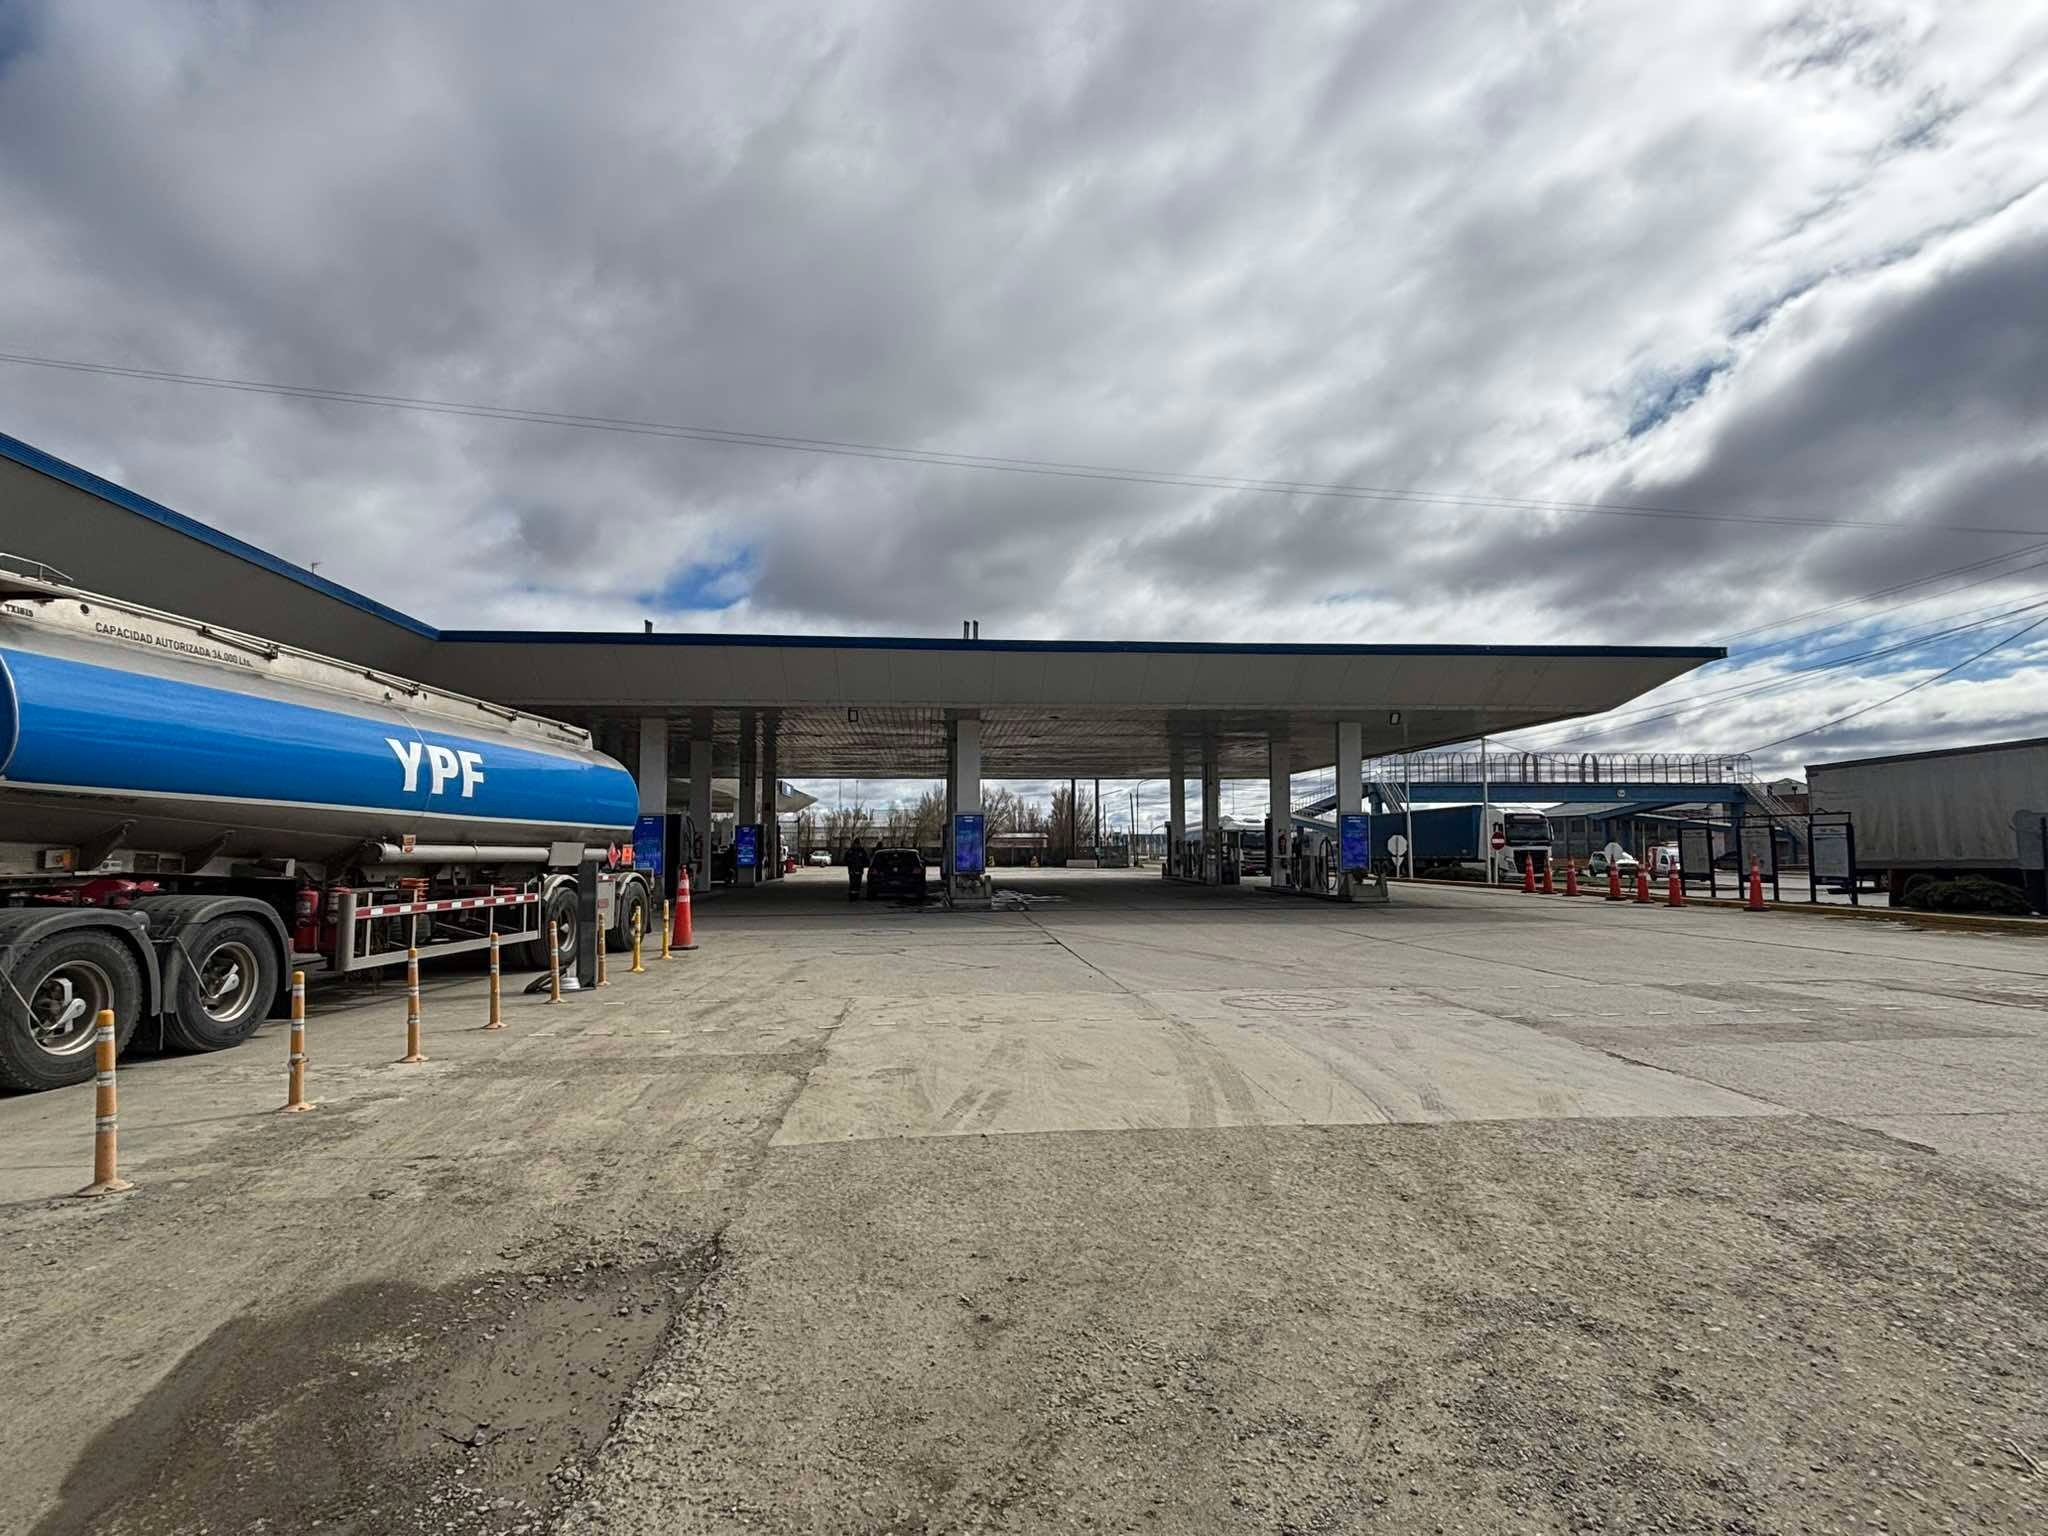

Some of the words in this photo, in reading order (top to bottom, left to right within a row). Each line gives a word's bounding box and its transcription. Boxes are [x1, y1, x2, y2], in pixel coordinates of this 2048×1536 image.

[95, 622, 153, 644] CAPACIDAD
[155, 637, 211, 658] AUTORIZADA
[384, 737, 484, 798] YPF
